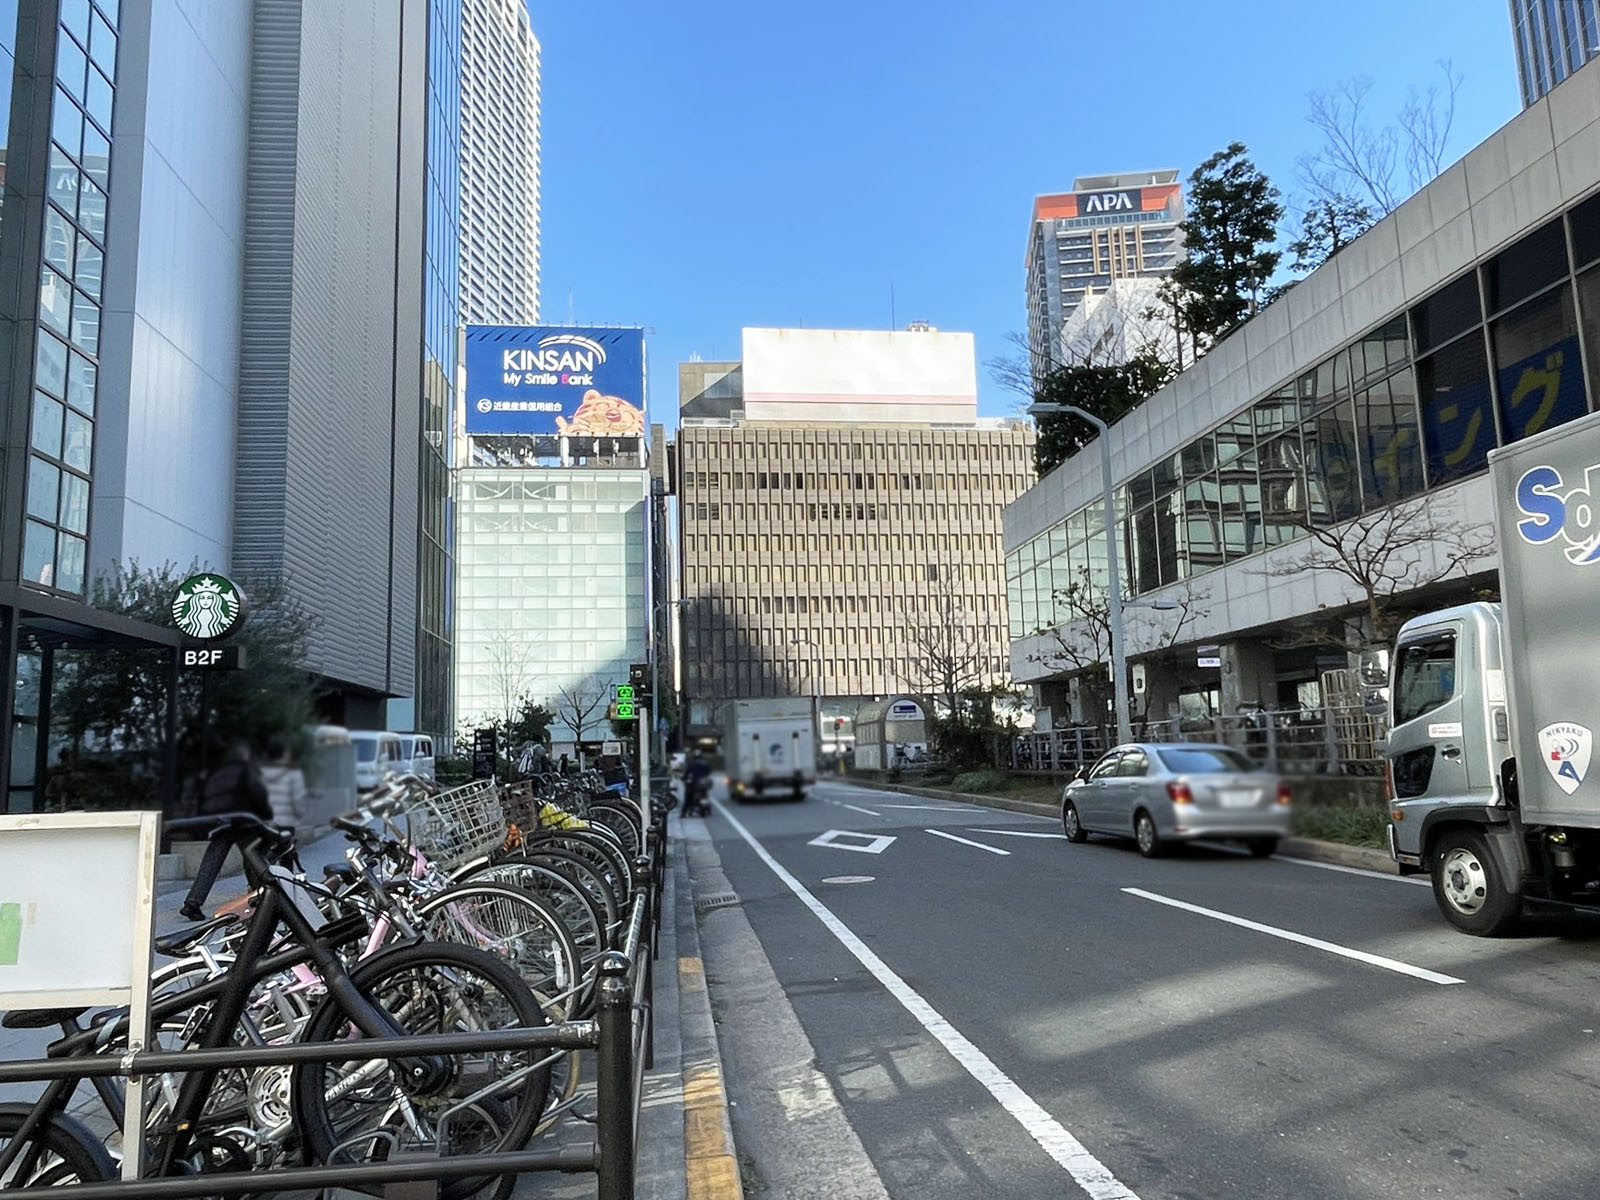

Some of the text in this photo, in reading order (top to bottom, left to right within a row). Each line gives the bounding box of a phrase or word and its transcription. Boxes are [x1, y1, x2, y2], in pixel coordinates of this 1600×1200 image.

[1086, 193, 1133, 212] APA
[503, 350, 593, 372] KINSAN
[504, 373, 593, 387] My Smile Bank
[185, 650, 222, 665] B2F
